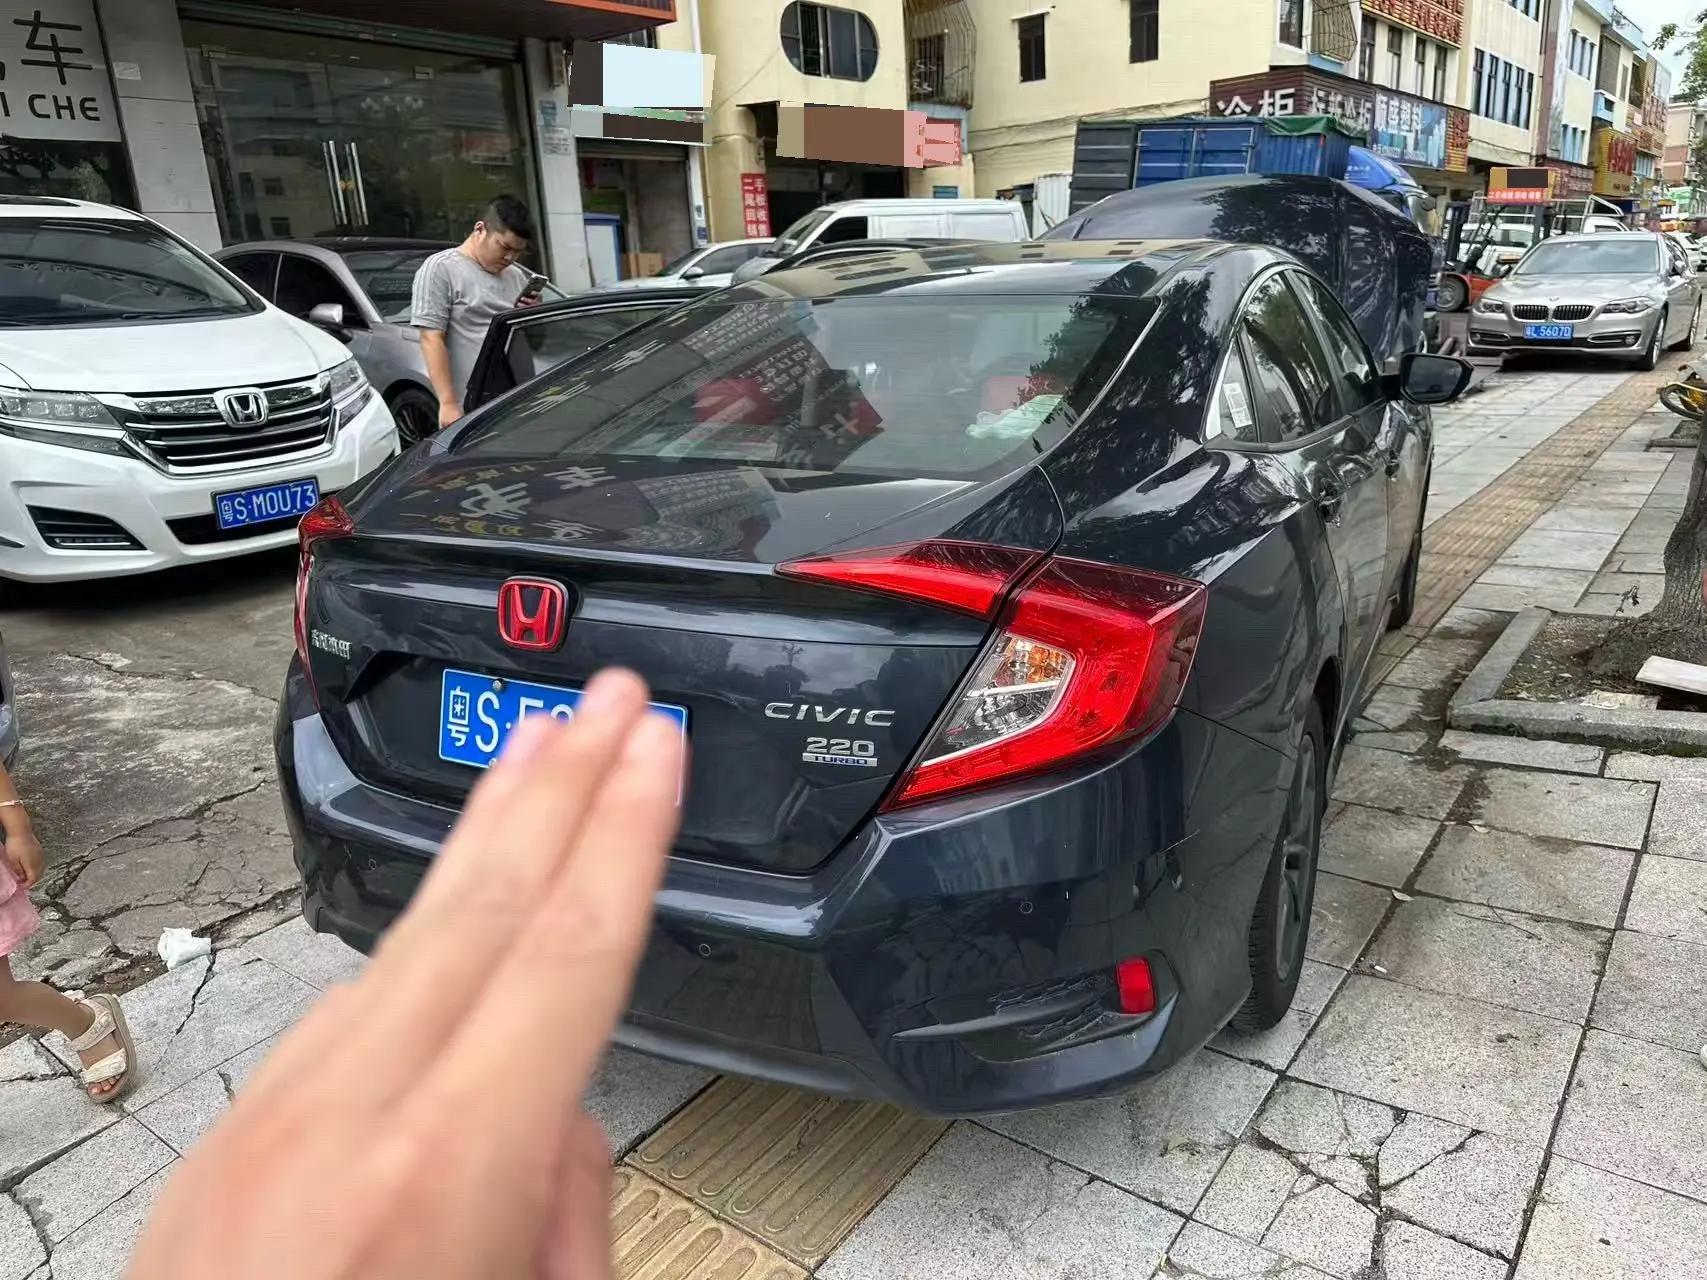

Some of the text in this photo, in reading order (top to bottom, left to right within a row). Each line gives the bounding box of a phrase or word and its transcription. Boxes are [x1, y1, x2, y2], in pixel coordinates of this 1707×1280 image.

[0, 10, 93, 86] 车
[27, 93, 101, 122] CHE
[1216, 87, 1296, 118] 冷柜
[764, 702, 896, 727] CIVIC
[806, 736, 875, 757] 220
[814, 755, 868, 765] TURBO
